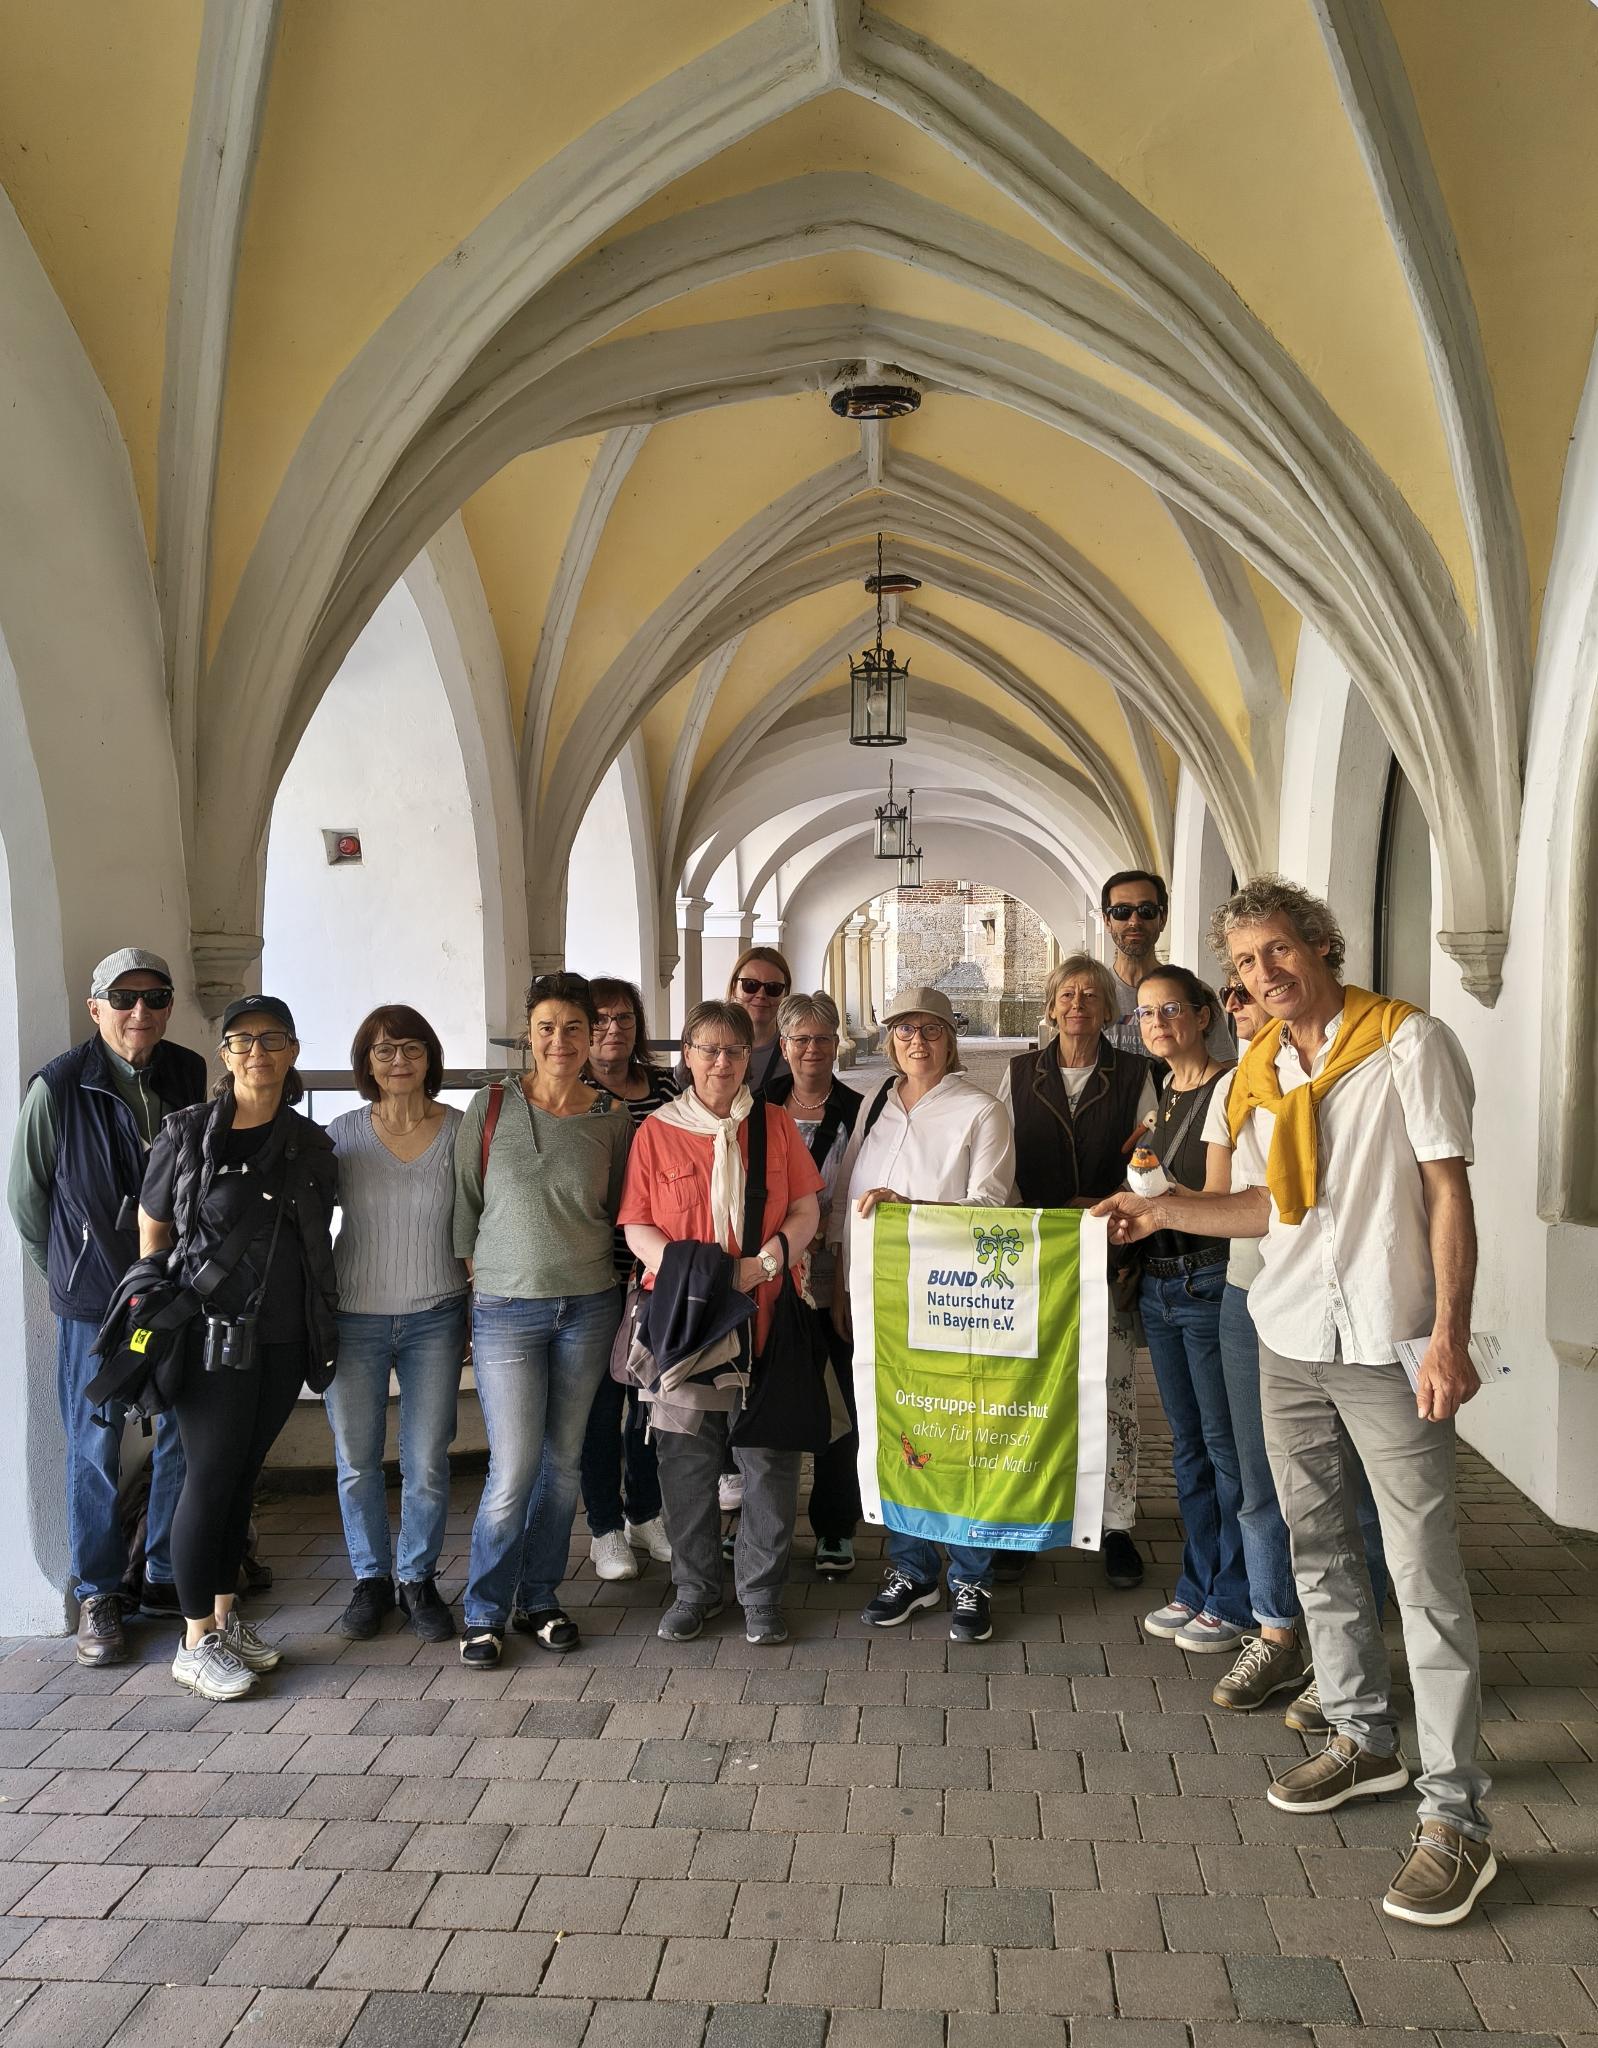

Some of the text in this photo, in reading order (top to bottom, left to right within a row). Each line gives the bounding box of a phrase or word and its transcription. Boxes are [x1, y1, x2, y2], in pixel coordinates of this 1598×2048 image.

[927, 1270, 978, 1287] BUND
[927, 1291, 1015, 1311] Naturschutz
[928, 1311, 1015, 1331] in Bayern e.V.
[895, 1389, 1049, 1419] Ortsgruppe Landshut
[912, 1420, 1031, 1447] aktiv für Mensch
[968, 1454, 1041, 1474] und Natur
